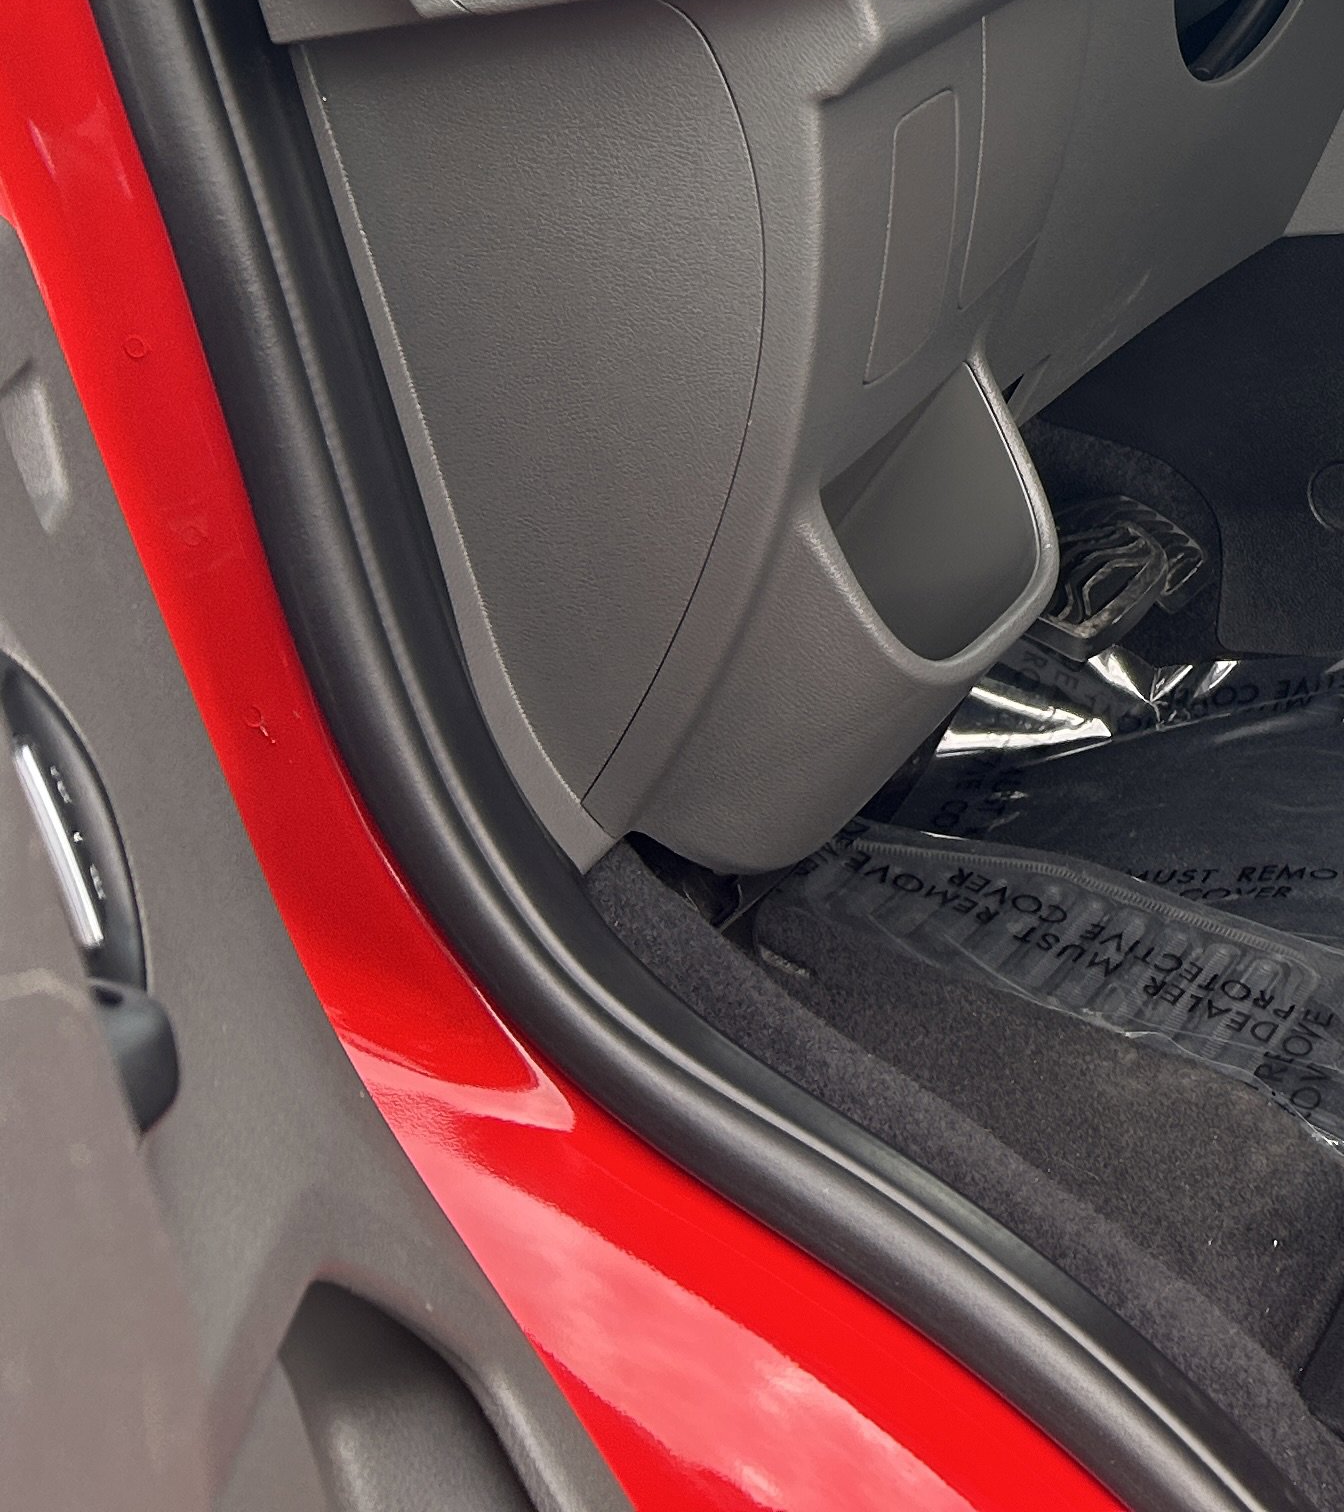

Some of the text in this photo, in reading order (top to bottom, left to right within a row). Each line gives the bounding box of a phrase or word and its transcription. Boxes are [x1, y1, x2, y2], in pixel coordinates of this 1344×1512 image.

[845, 850, 1280, 1042] DEALER MUST REMOVE
[949, 867, 1296, 1022] PROTECTIVE COVER
